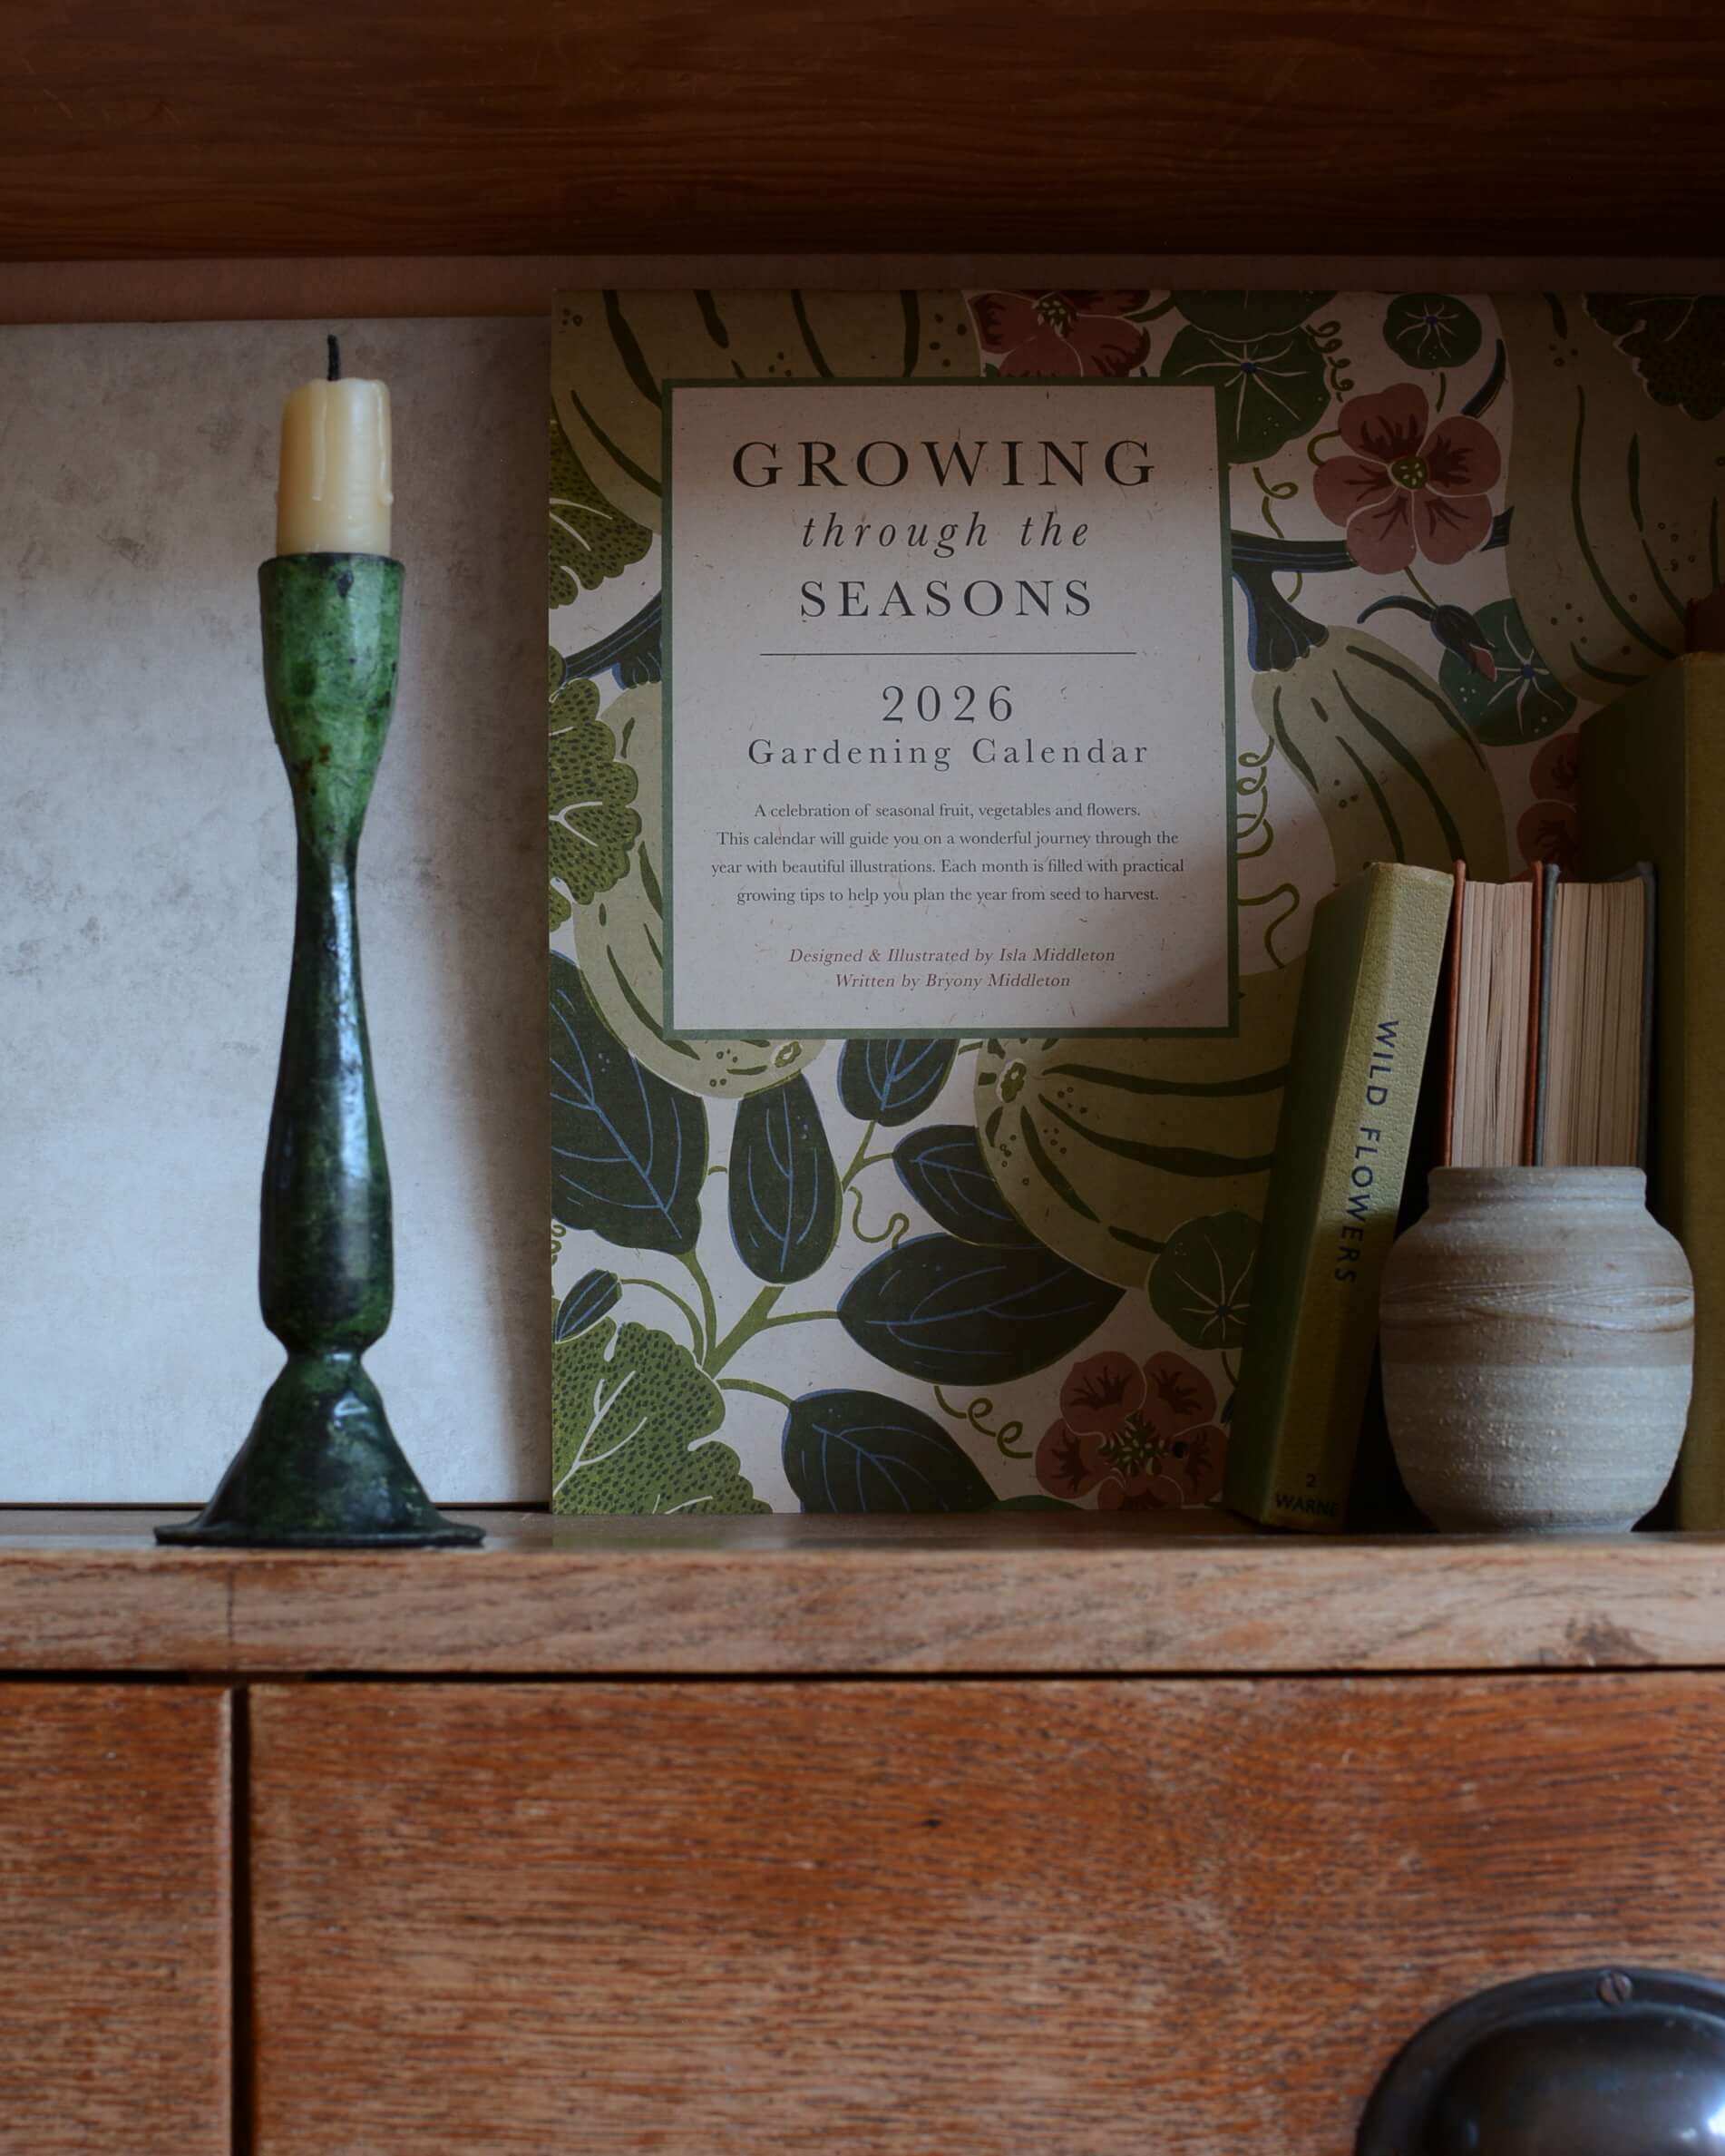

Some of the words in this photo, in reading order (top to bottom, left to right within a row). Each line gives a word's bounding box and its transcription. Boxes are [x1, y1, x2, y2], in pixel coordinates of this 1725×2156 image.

[732, 439, 1155, 488] GROWING
[802, 511, 988, 559] through
[1020, 510, 1088, 547] the
[800, 580, 1091, 618] SEASONS
[882, 685, 1013, 725] 2026
[748, 737, 951, 773] Gardening
[972, 737, 1147, 764] Calendar
[754, 804, 766, 818] A
[770, 803, 851, 818] celebration
[853, 803, 872, 817] of
[874, 803, 935, 817] seasonal
[939, 802, 975, 820] fruit,
[978, 802, 1052, 821] vegetables
[1055, 802, 1083, 817] and
[1087, 802, 1141, 817] flowers.
[716, 831, 750, 846] This
[753, 830, 816, 845] calendar
[819, 831, 845, 845] will
[849, 831, 890, 850] guide
[892, 834, 920, 849] you
[923, 834, 942, 845] on
[946, 834, 955, 845] a
[959, 830, 1032, 845] wonderful
[1033, 830, 1092, 849] journey
[1095, 830, 1153, 848] through
[1156, 830, 1179, 844] the
[711, 863, 743, 878] year
[745, 859, 777, 874] with
[782, 858, 845, 874] beautiful
[849, 858, 936, 873] illustrations.
[940, 858, 978, 873] Each
[981, 858, 1029, 873] month
[1032, 858, 1045, 873] is
[1048, 858, 1084, 873] filled
[1087, 858, 1118, 873] with
[1122, 858, 1184, 877] practical
[736, 887, 796, 906] growing
[800, 887, 825, 906] tips
[829, 890, 844, 902] to
[848, 887, 879, 905] help
[882, 892, 909, 905] you
[913, 887, 945, 906] plan
[950, 886, 973, 901] the
[976, 891, 1009, 905] year
[1011, 886, 1046, 901] from
[1049, 886, 1081, 901] seed
[1085, 890, 1100, 901] to
[1104, 886, 1159, 901] harvest.
[788, 948, 864, 966] Designed
[868, 949, 882, 962] &
[886, 948, 970, 962] Illustrated
[974, 947, 995, 966] by
[999, 947, 1027, 962] Isla
[1031, 947, 1116, 962] Middleton
[835, 973, 895, 988] Written
[901, 972, 921, 991] by
[925, 972, 984, 991] Bryony
[987, 972, 1070, 988] Middleton
[1366, 1020, 1399, 1106] WILD
[1334, 1127, 1381, 1284] FLOWERS
[1276, 1493, 1340, 1517] WARNE
